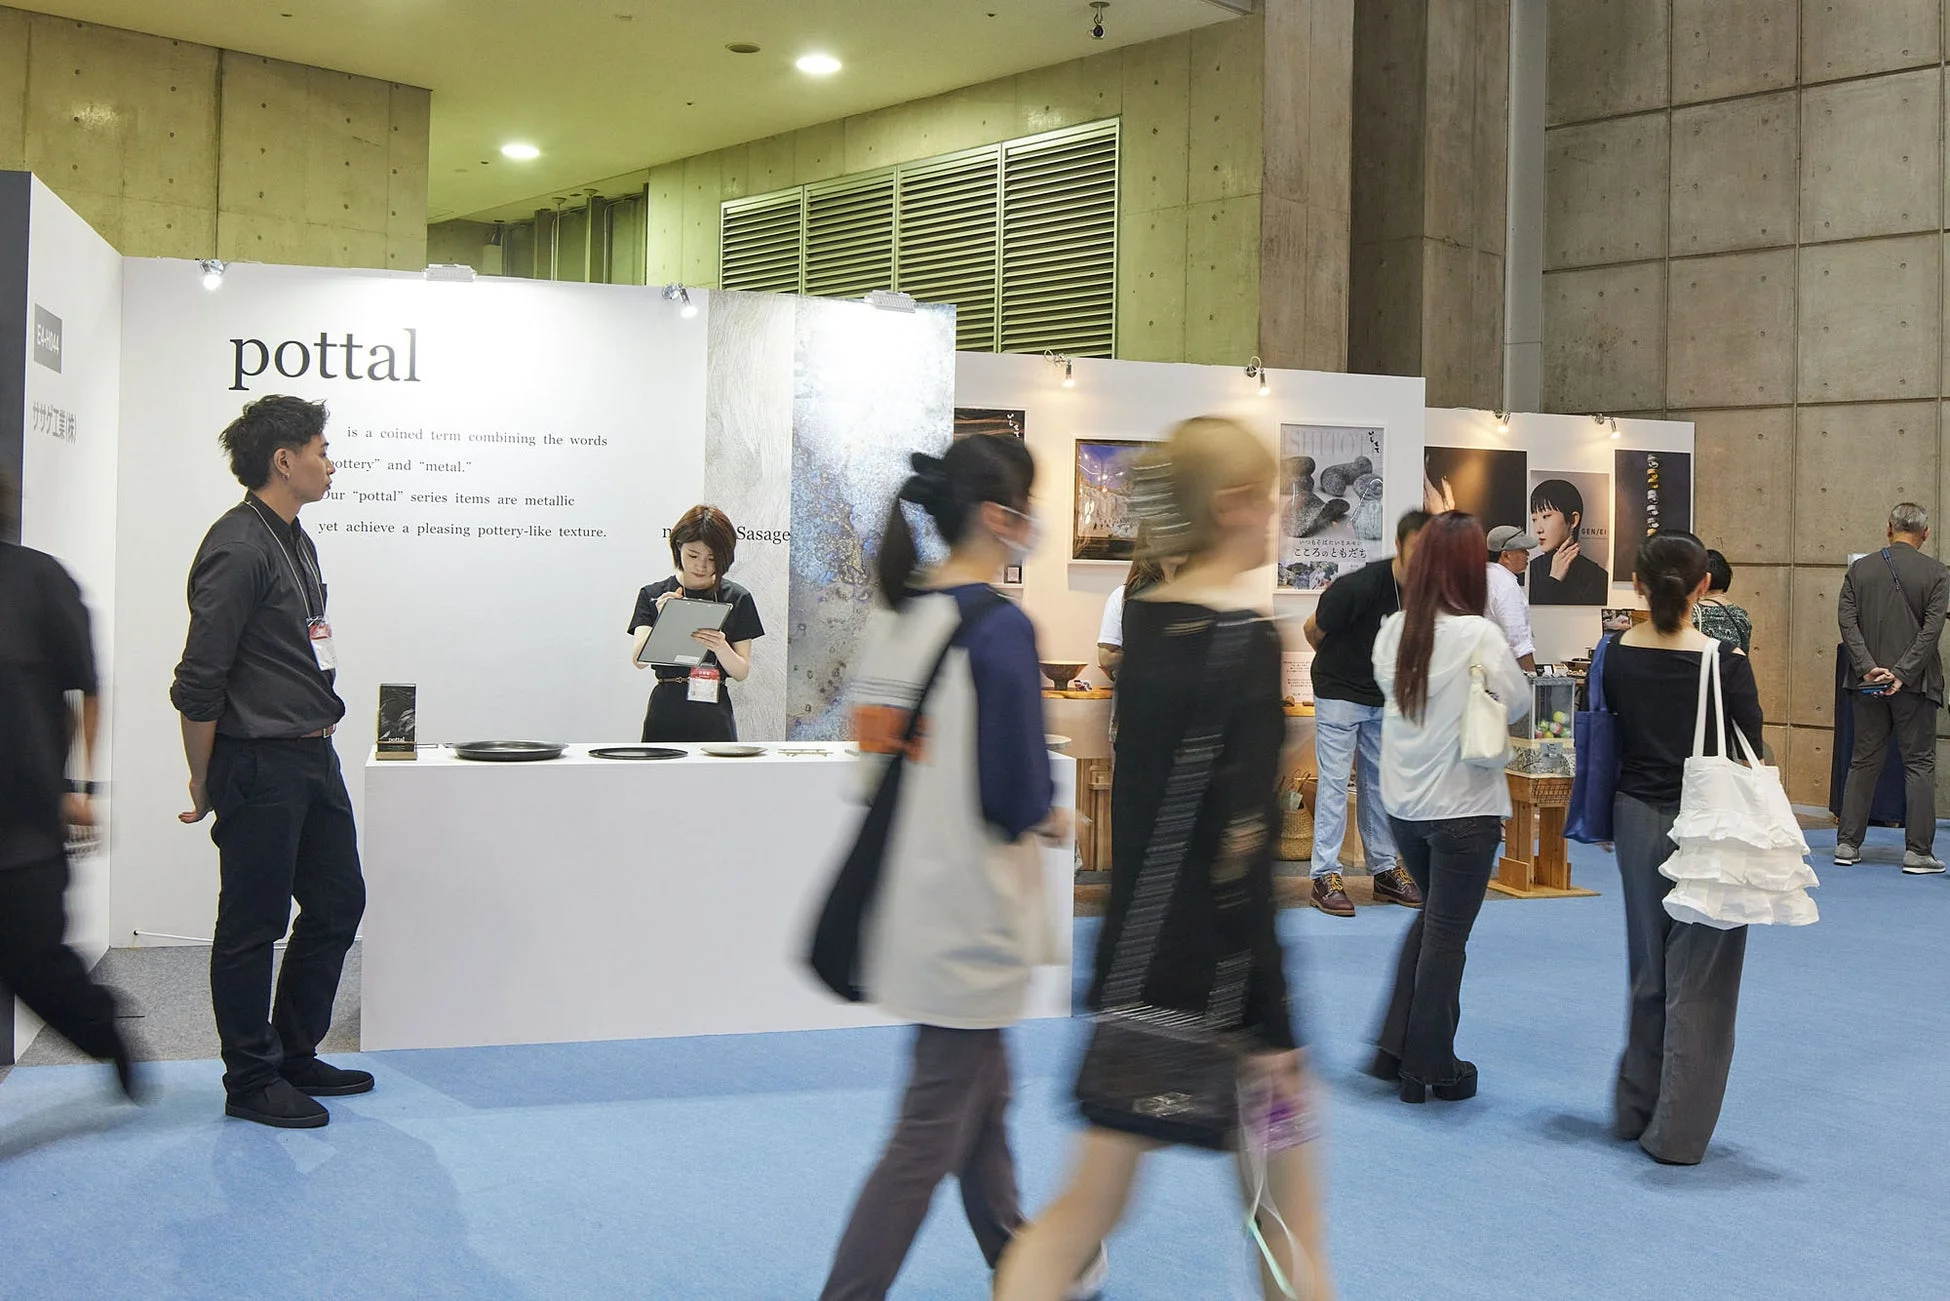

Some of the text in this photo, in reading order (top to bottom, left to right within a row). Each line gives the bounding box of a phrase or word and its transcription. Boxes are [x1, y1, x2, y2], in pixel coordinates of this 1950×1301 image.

[36, 324, 60, 356] E4-H044
[228, 327, 421, 391] pottal
[347, 426, 608, 446] is a coined term combining the words
[331, 458, 472, 473] ottery” and “metal.”
[352, 490, 403, 504] “pottal”
[410, 492, 448, 503] series
[455, 493, 491, 504] items
[497, 496, 518, 505] are
[525, 495, 575, 506] metallic
[318, 521, 607, 539] yet achieve a pleasing pottery-like texture.
[736, 526, 791, 544] Sasage
[1294, 547, 1367, 559] こころのともだち
